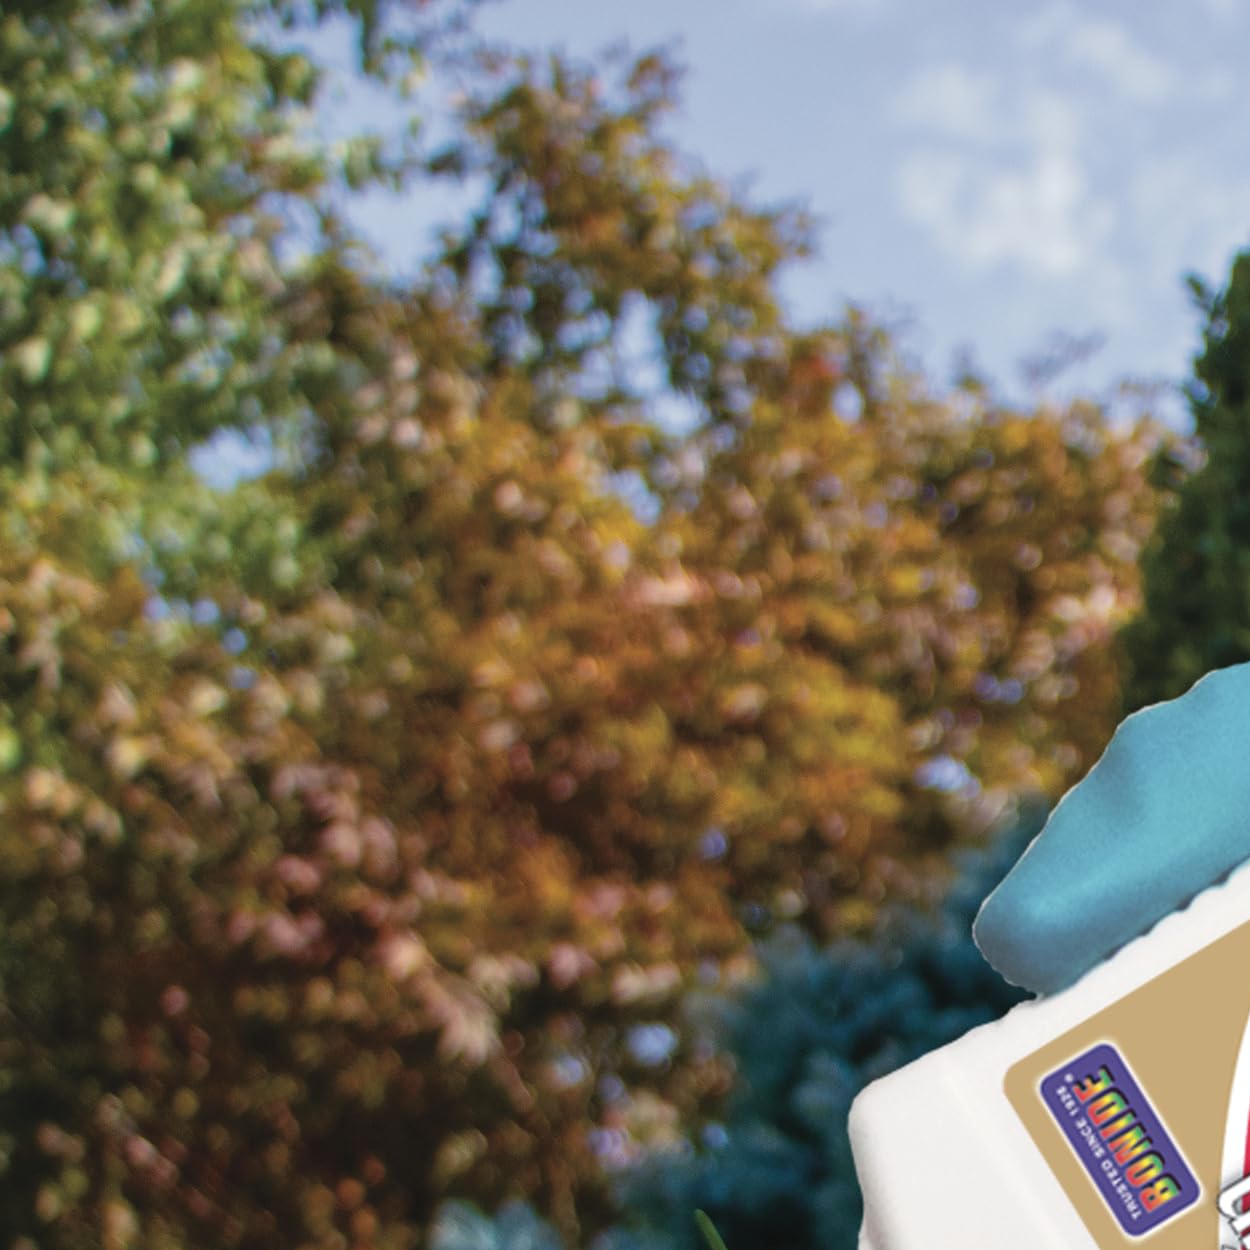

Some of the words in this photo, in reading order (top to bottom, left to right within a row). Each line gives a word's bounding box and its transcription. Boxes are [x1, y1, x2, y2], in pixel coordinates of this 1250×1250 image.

[1074, 1064, 1181, 1212] BONIDE
[1075, 1117, 1105, 1158] SINCE
[1100, 1158, 1142, 1220] TRUSTED
